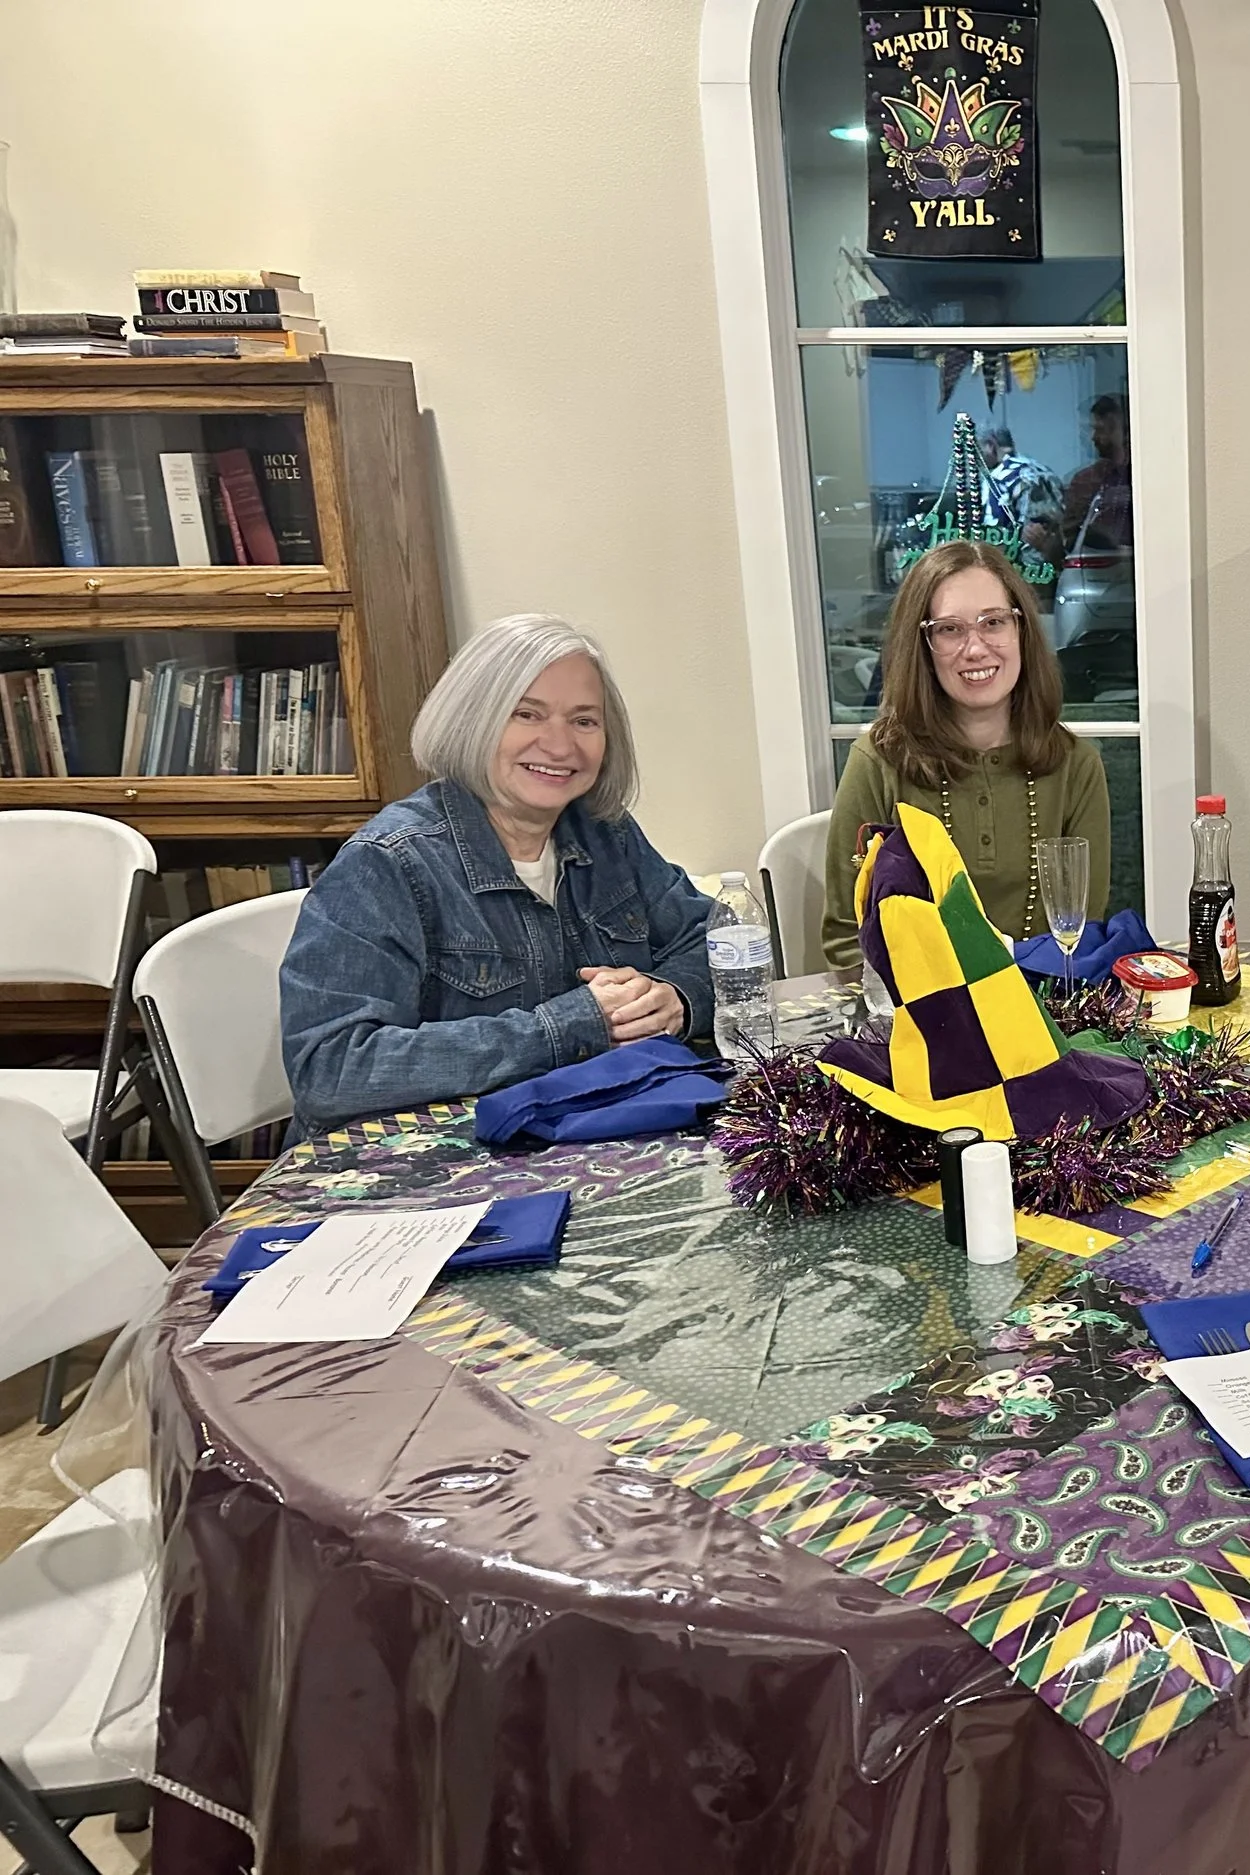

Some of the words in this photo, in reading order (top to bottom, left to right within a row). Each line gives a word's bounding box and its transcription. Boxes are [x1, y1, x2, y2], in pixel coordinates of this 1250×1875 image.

[922, 5, 974, 31] IT'S
[872, 29, 949, 61] MARDI
[960, 32, 1025, 66] GRAS
[910, 199, 995, 228] Y'ALL
[166, 289, 251, 314] CHRIST
[263, 454, 298, 466] HOLY
[266, 467, 301, 480] BIBLE
